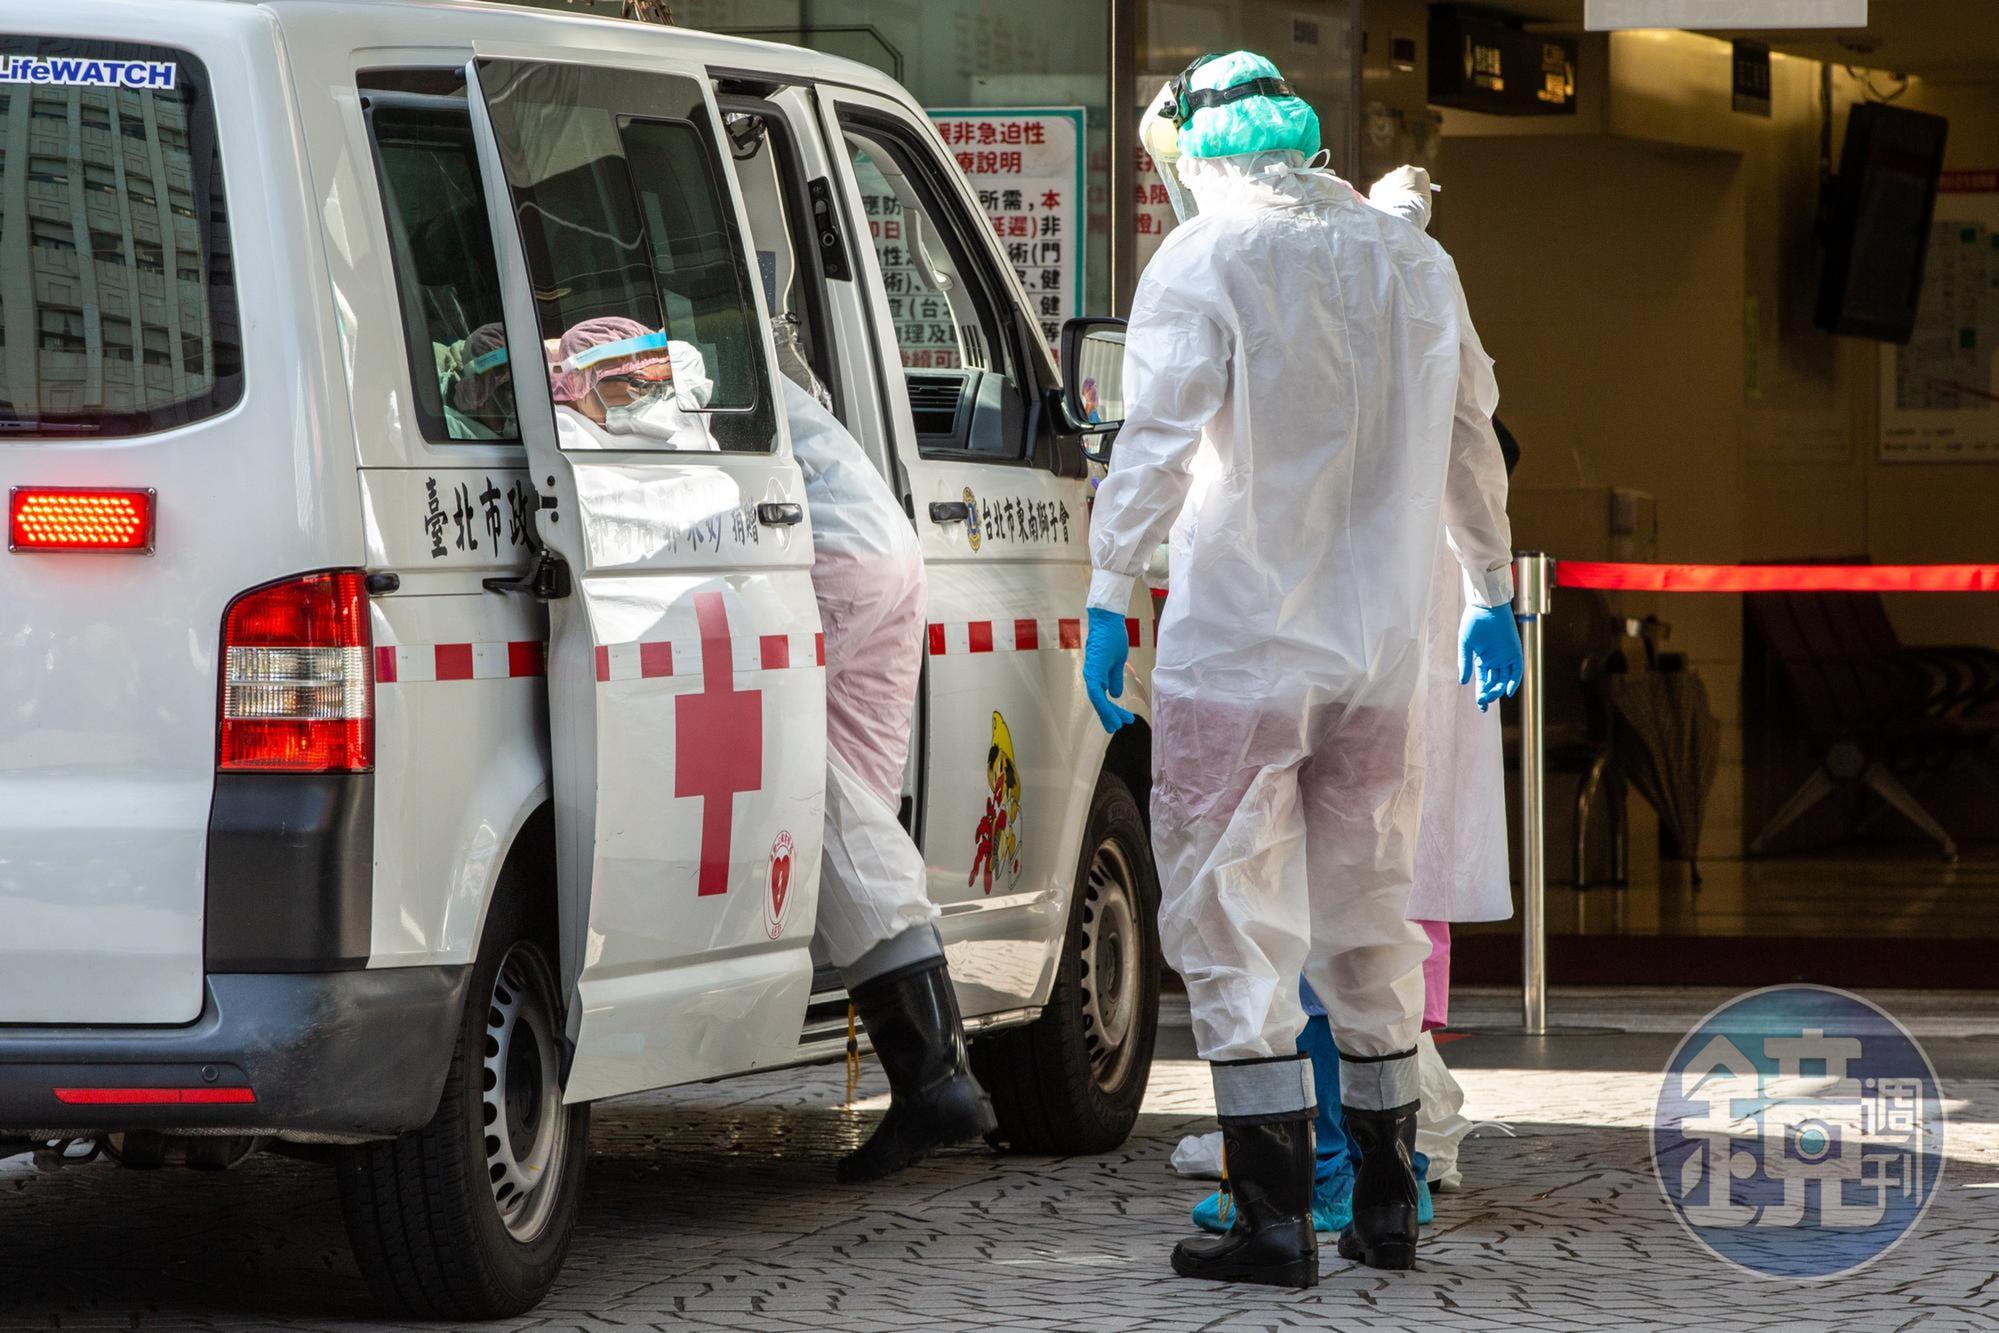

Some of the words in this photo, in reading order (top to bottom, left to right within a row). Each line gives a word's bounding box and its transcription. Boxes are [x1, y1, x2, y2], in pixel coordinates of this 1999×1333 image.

[982, 496, 1070, 545] 台北市東南獅子會
